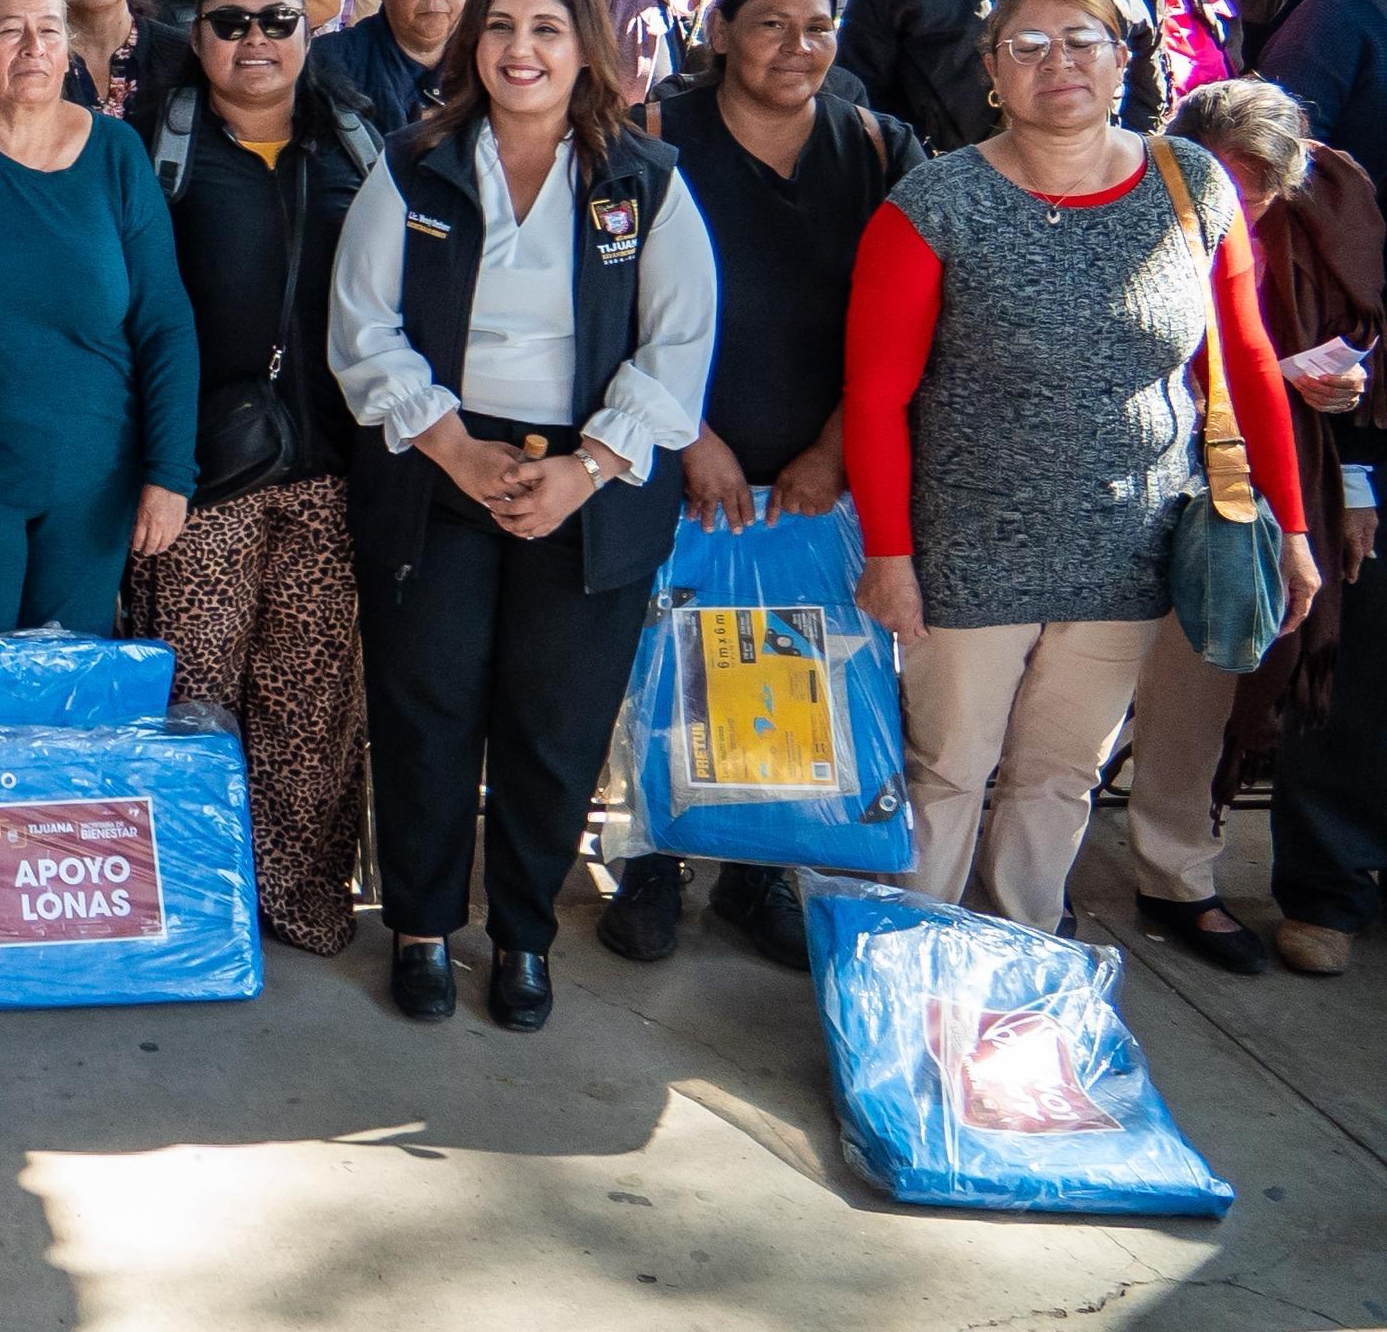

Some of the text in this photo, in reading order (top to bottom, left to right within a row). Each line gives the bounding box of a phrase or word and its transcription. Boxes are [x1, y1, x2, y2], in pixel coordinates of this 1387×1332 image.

[28, 822, 74, 834] TIJUANA
[81, 827, 138, 840] BIENESTAR
[15, 855, 131, 888] APOYO
[21, 888, 131, 921] LONAS
